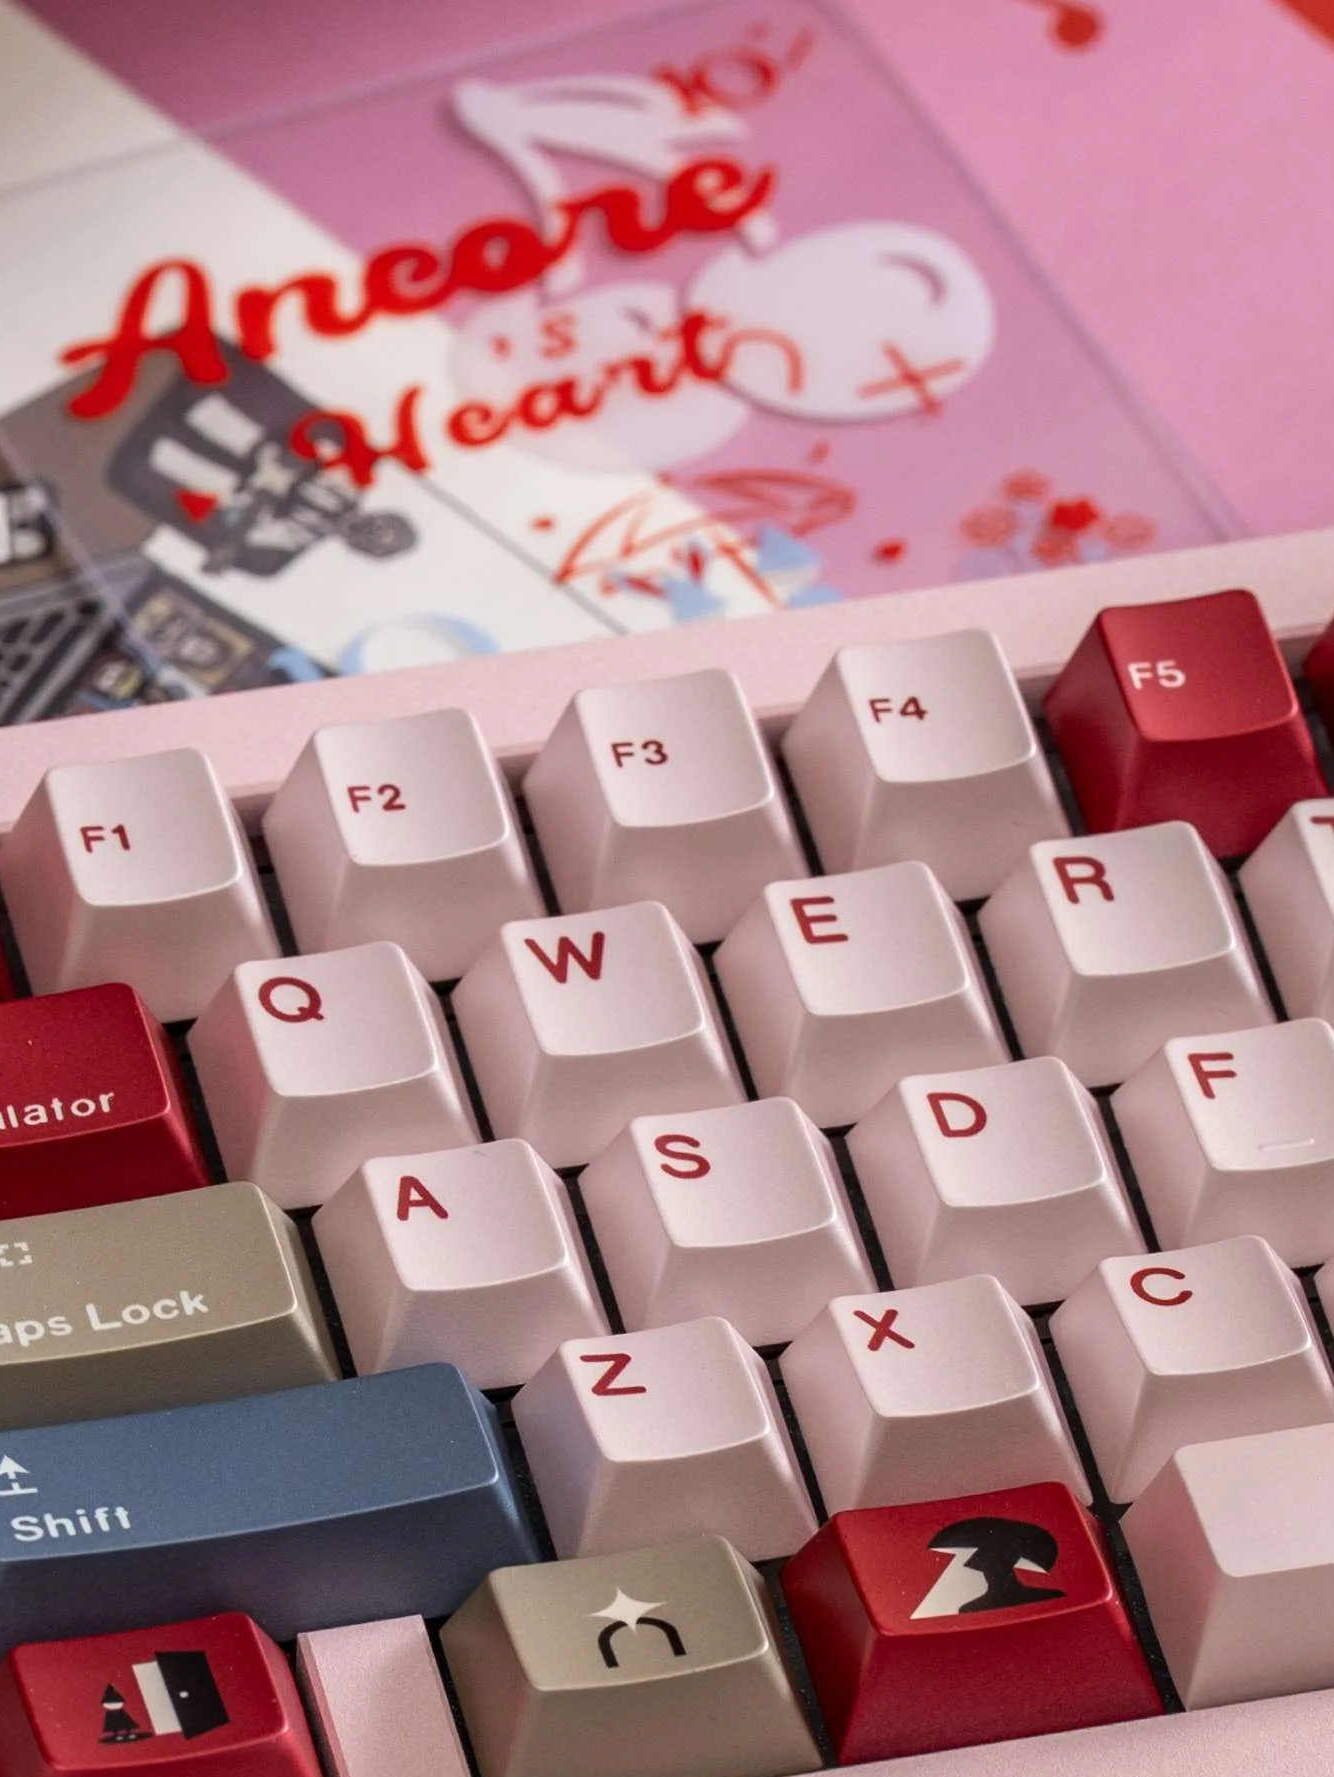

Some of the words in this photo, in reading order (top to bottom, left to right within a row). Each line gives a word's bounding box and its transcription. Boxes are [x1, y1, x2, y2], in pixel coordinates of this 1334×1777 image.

[60, 154, 776, 416] Ancore
[293, 309, 803, 487] Heart
[1128, 661, 1185, 689] F5
[869, 696, 927, 722] F4
[611, 740, 668, 767] F3
[348, 784, 406, 813] F2
[80, 824, 130, 853] F1
[1053, 856, 1114, 904] R
[791, 896, 848, 944] E
[525, 932, 605, 983] W
[259, 977, 324, 1023] Q
[1188, 1052, 1236, 1099] F
[927, 1093, 987, 1137] D
[655, 1135, 710, 1179] S
[397, 1176, 448, 1221] A
[1131, 1268, 1193, 1306] C
[86, 1291, 208, 1331] Lock
[854, 1309, 915, 1351] X
[580, 1353, 646, 1396] Z
[11, 1507, 130, 1541] Shift
